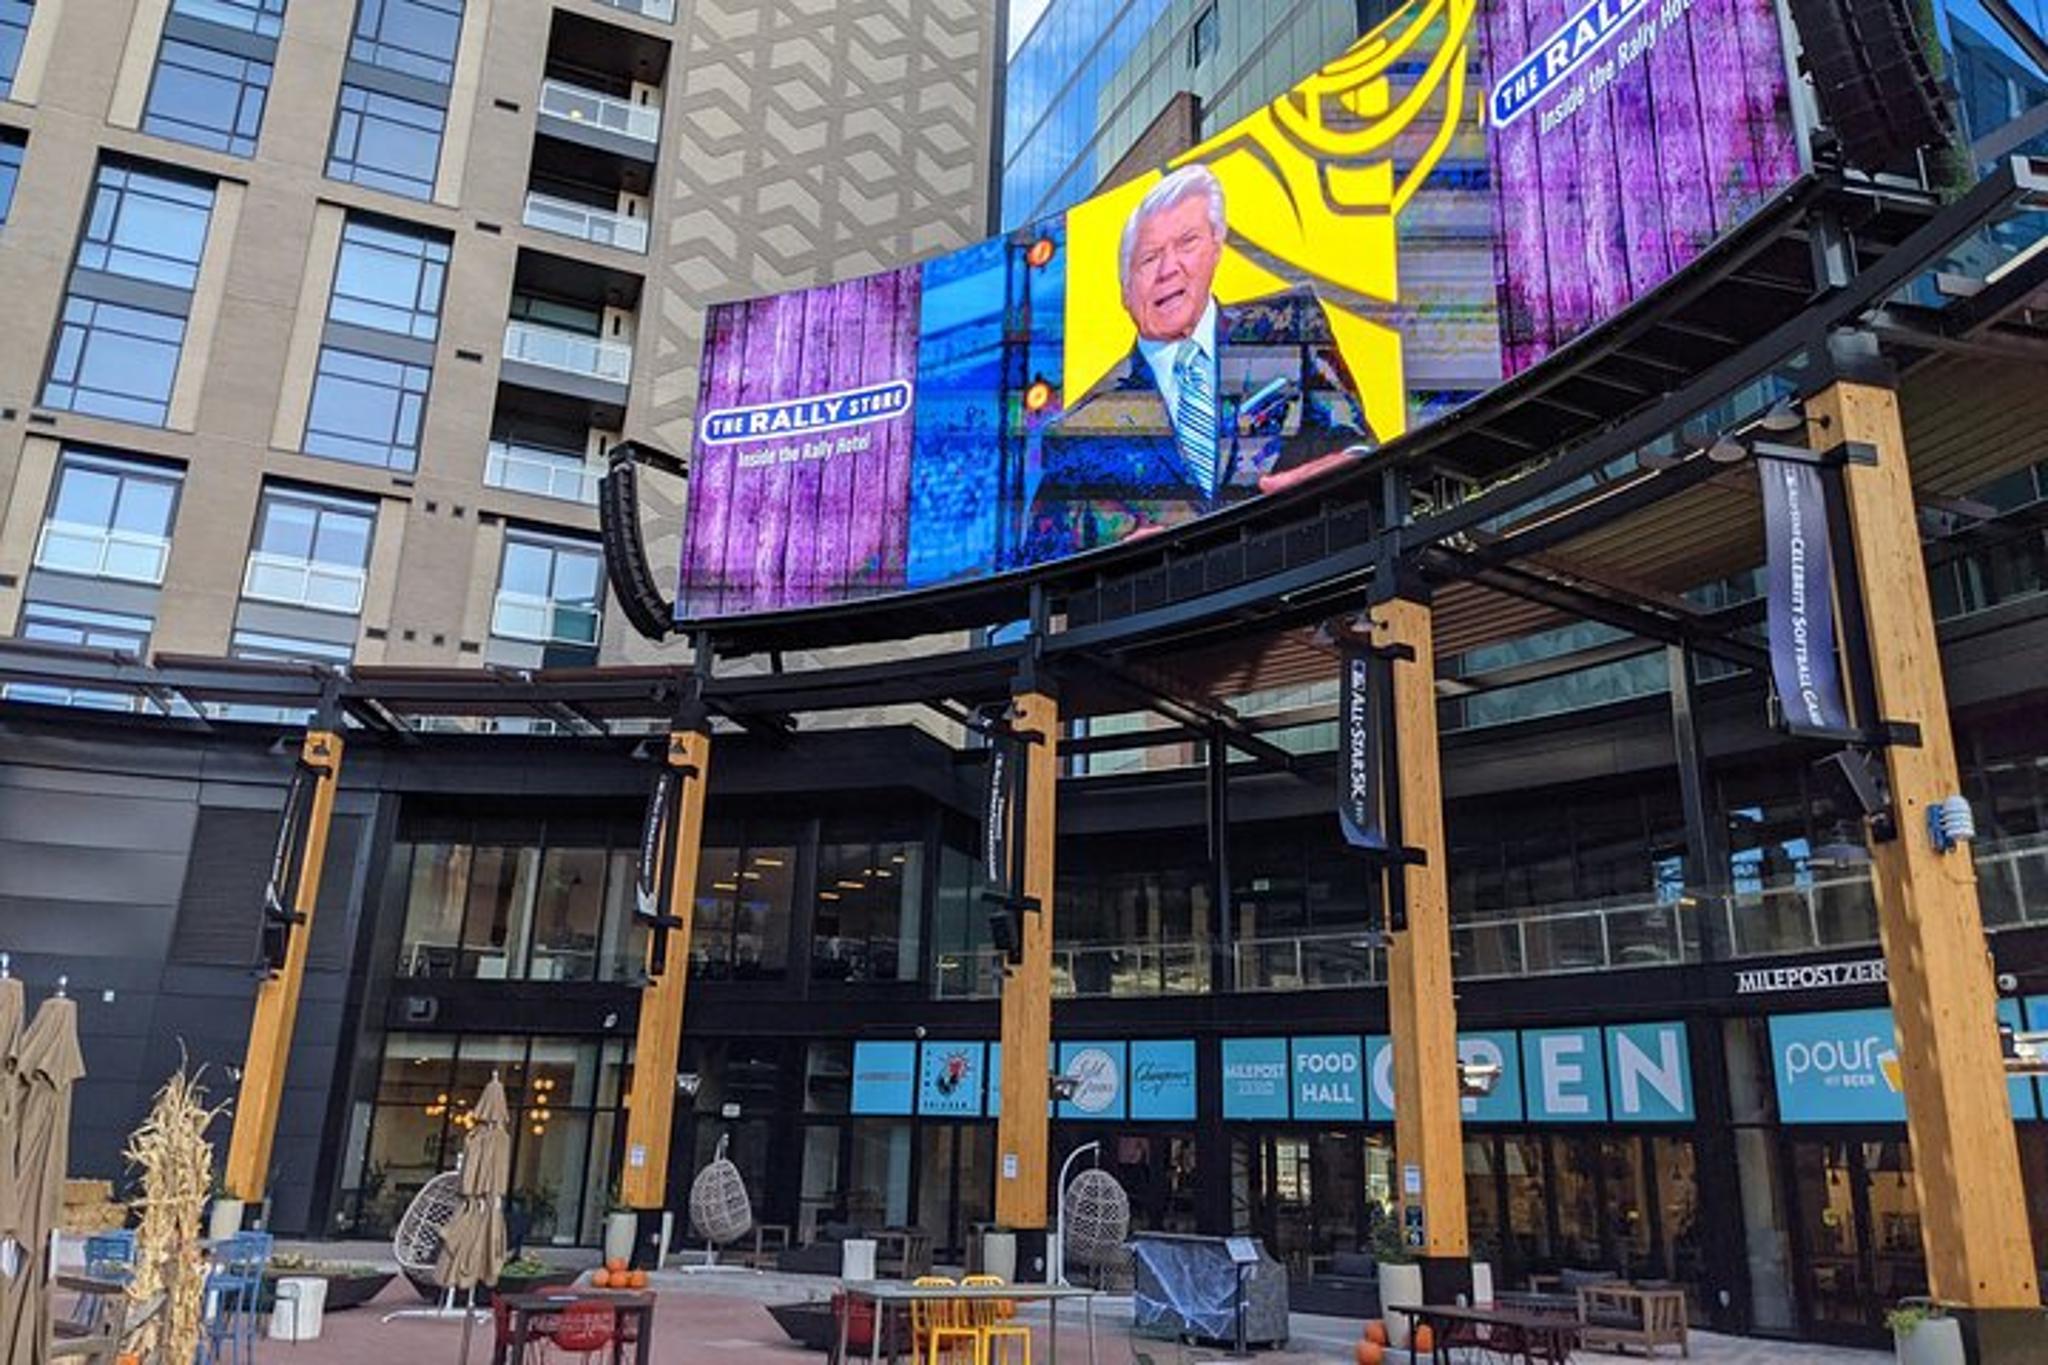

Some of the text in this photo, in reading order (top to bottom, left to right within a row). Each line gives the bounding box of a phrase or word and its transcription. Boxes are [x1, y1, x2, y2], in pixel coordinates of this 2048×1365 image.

[1500, 65, 1539, 109] THE
[1540, 85, 1585, 135] Inside
[1589, 60, 1614, 93] the
[1617, 20, 1656, 70] Rally
[712, 390, 902, 436] THE RALLY STORE
[738, 433, 871, 467] Inside the Rally Hotel
[1790, 537, 1805, 614] CELEBRITY
[1791, 617, 1813, 689] SOFTBALL
[1735, 959, 1888, 993] MILEPOST ZER
[1296, 1053, 1357, 1073] FOOD
[1372, 1028, 1687, 1114] PEN
[1785, 1036, 1880, 1085] pour
[1302, 1083, 1355, 1103] HALL
